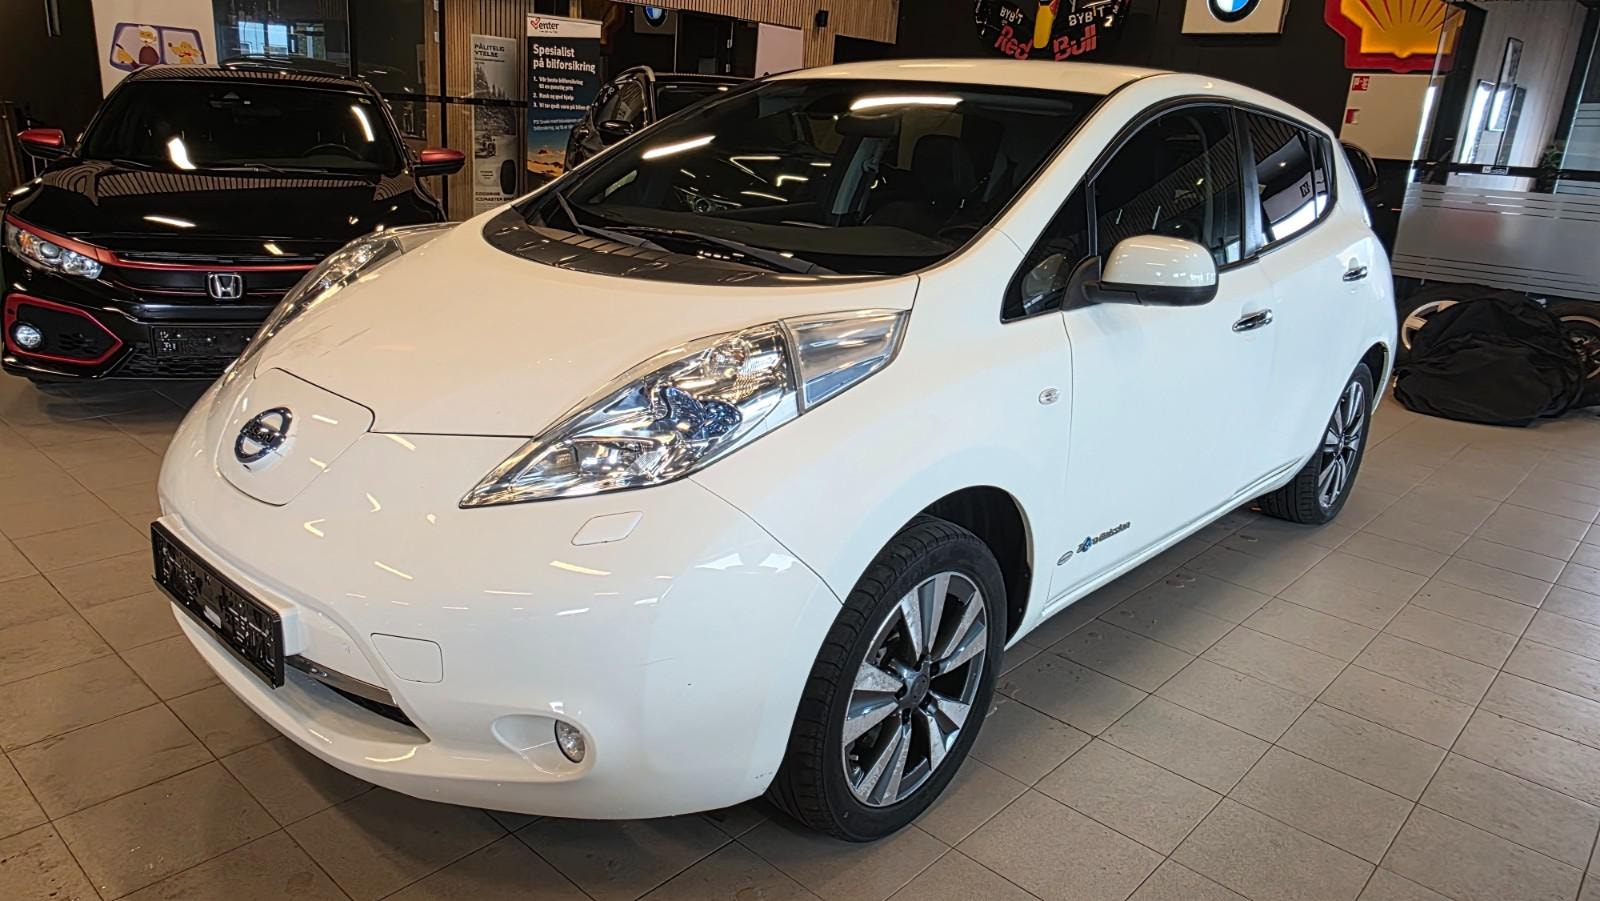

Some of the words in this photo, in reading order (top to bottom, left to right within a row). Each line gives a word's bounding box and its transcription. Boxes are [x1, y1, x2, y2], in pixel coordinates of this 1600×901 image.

[1069, 6, 1105, 26] BYBIT
[533, 43, 575, 58] Spesialist
[994, 25, 1033, 60] Red
[1053, 24, 1097, 61] Bull
[533, 57, 545, 70] på
[546, 58, 596, 75] bilforsikring
